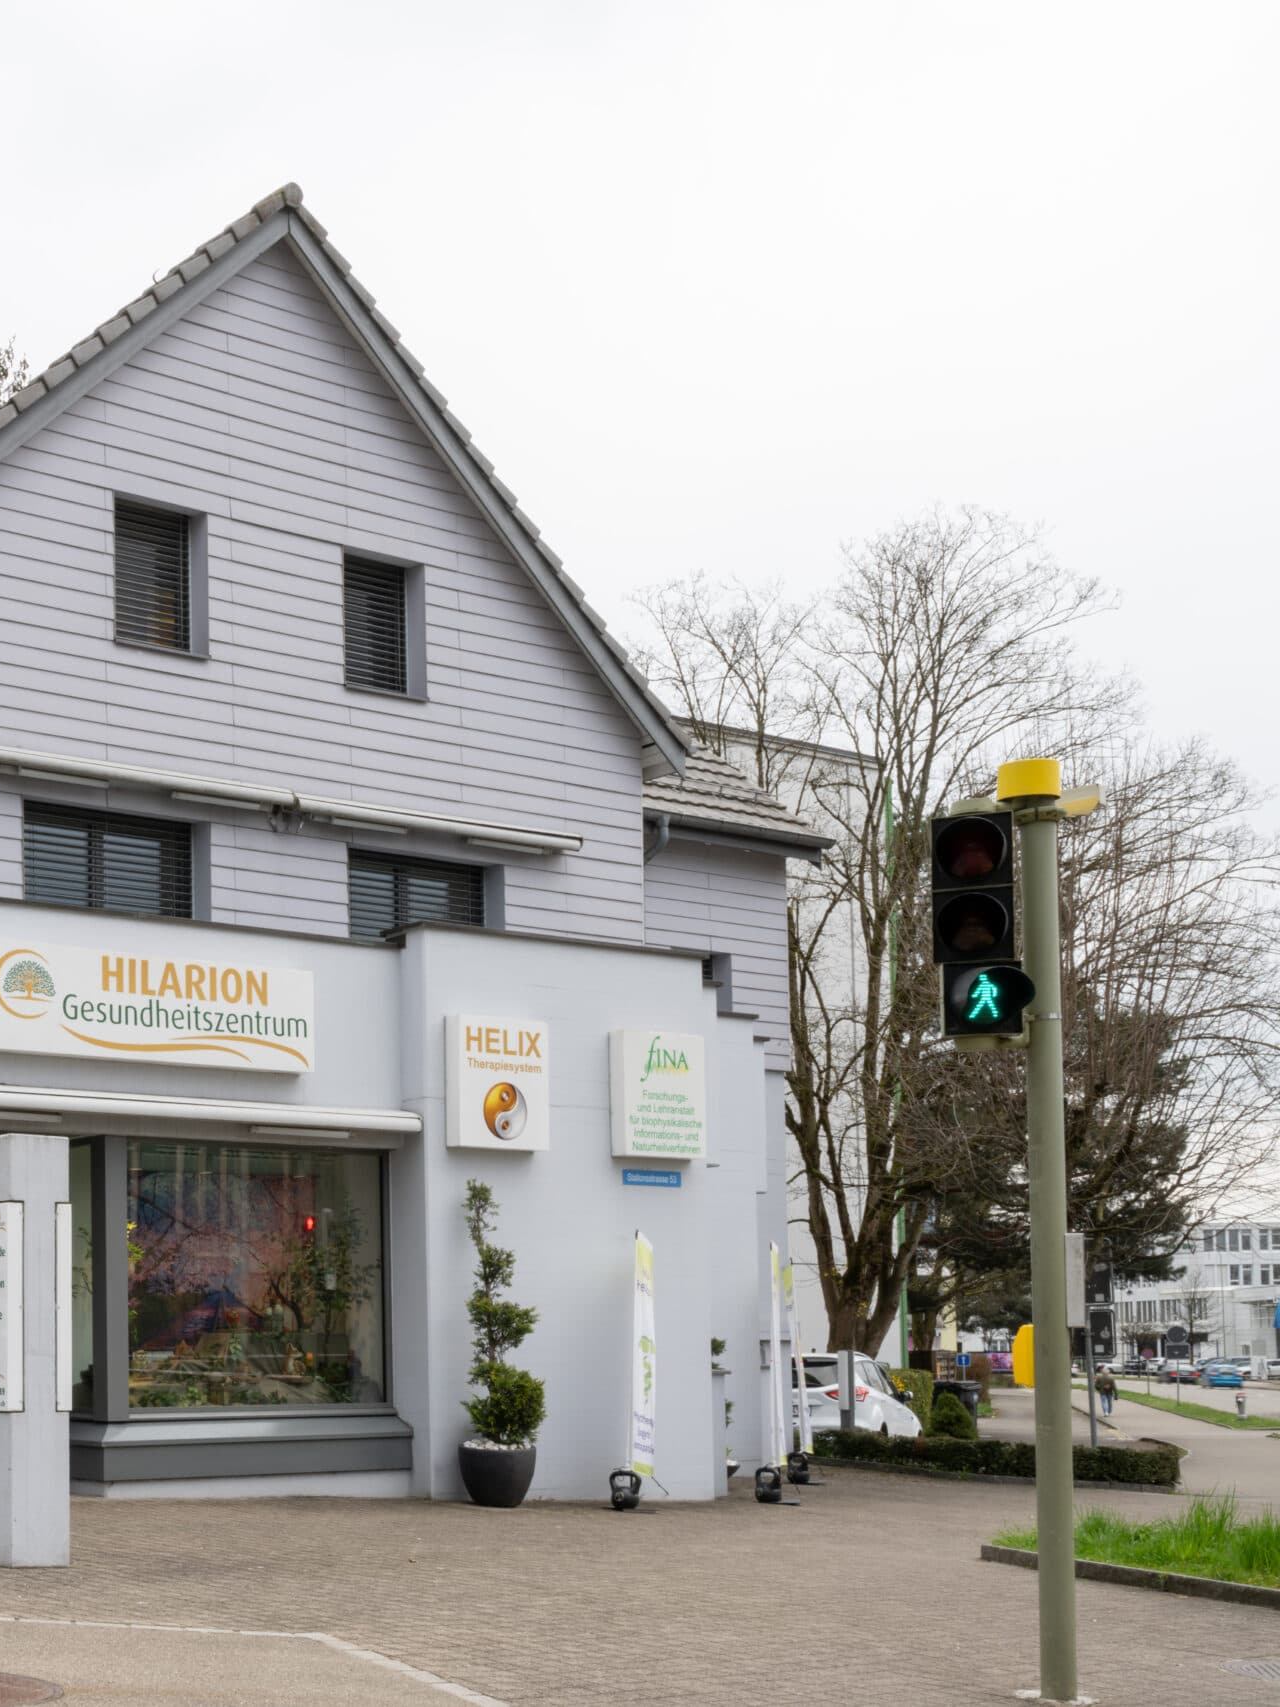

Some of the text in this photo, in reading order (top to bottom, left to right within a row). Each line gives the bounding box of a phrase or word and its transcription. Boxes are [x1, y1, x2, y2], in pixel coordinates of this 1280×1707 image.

[101, 955, 269, 1007] HILARION
[62, 993, 308, 1039] Gesundheitszentrum
[465, 1025, 543, 1058] HELIX
[467, 1057, 543, 1075] Therapiesystem
